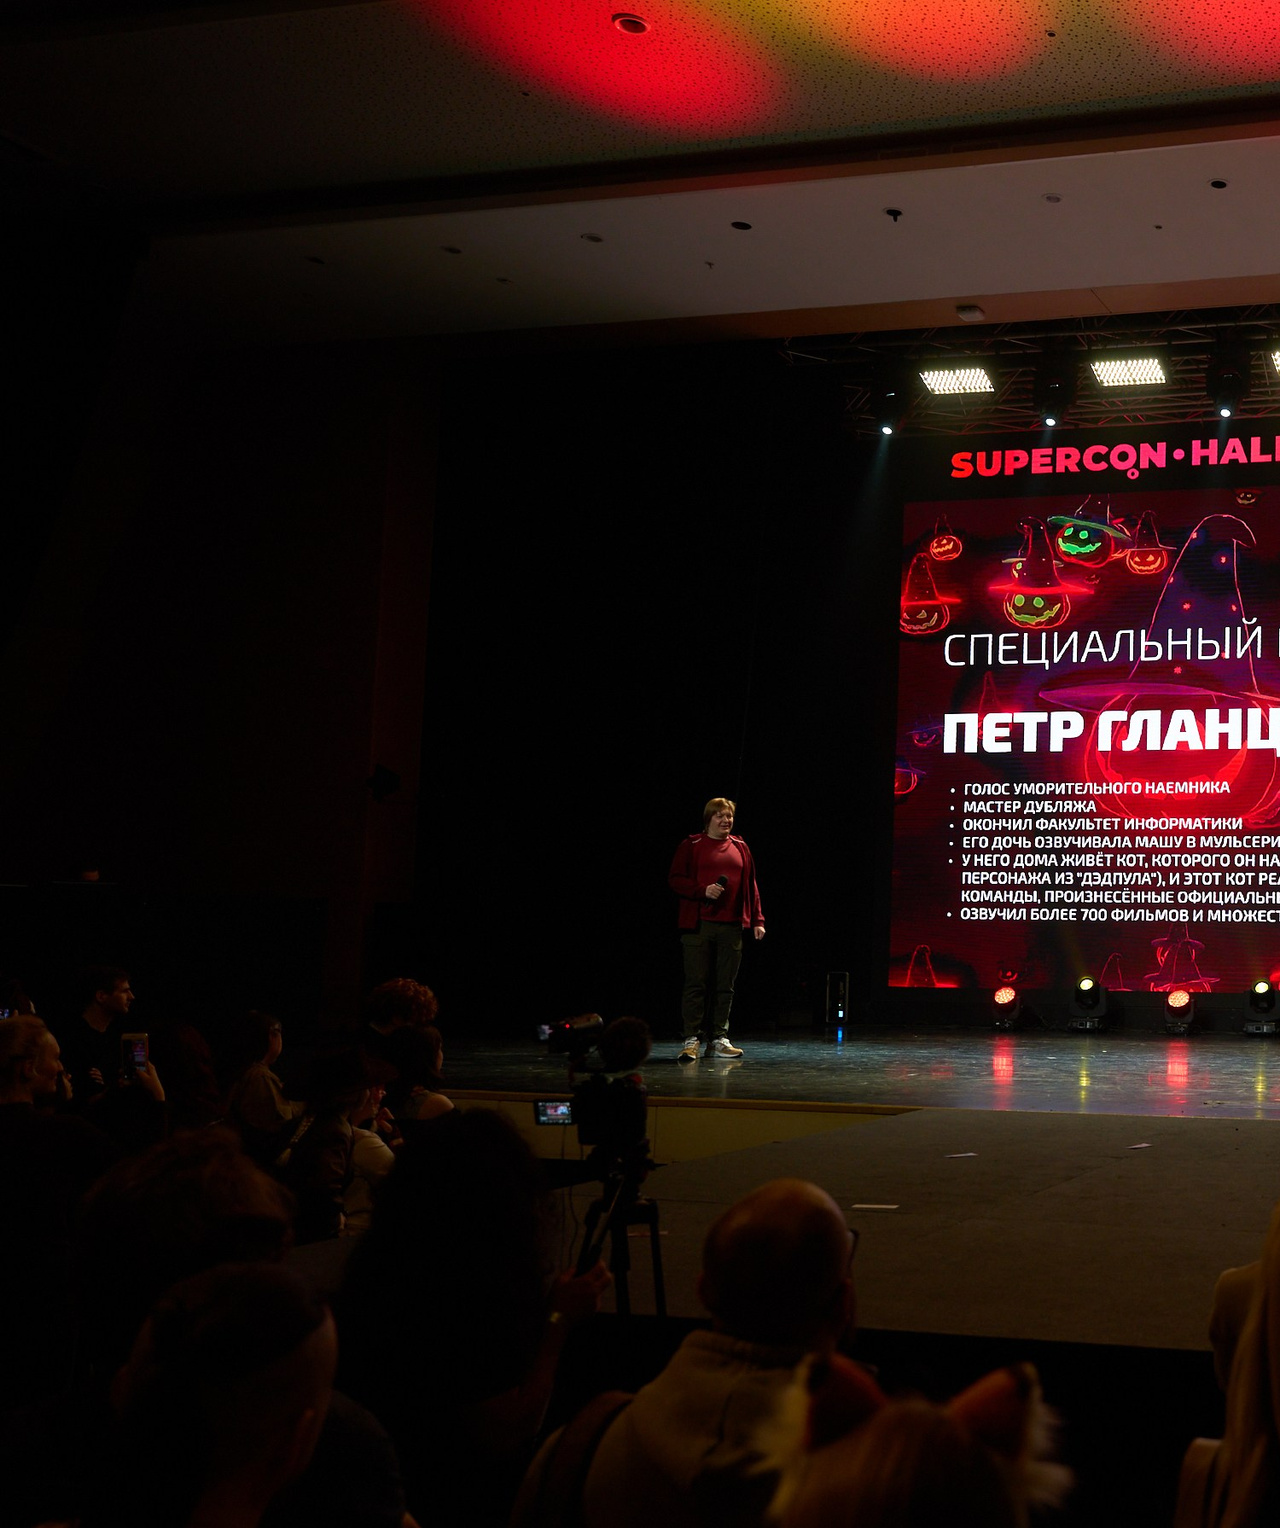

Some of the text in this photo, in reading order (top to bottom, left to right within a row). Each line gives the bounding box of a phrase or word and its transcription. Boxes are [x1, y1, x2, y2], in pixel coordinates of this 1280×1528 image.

[950, 440, 1166, 479] SUPERCON
[943, 617, 1263, 671] СПЕЦИАЛЬНЫЙ
[943, 711, 1084, 754] ПЕТР
[964, 781, 1231, 796] ГОЛОС УМОРИТЕЛЬНОГО НАЕМНИКА
[963, 800, 1097, 815] МАСТЕР ДУБЛЯЖА
[963, 817, 1243, 831] ОКОНЧИЛ ФАКУЛЬТЕТ ИНФОРМАТИКИ
[962, 836, 989, 849] ЕГО
[991, 836, 1032, 851] ДОЧЬ
[1034, 836, 1132, 849] ОЗВУЧИВАЛА
[1135, 836, 1183, 848] МАШУ
[1186, 836, 1196, 848] В
[961, 854, 971, 867] У
[974, 854, 1010, 867] НЕГО
[1013, 854, 1058, 869] ДОМА
[1060, 852, 1114, 867] ЖИВЁТ
[1116, 854, 1149, 869] КОТ,
[1151, 854, 1231, 867] КОТОРОГО
[1234, 854, 1256, 867] ОН
[961, 872, 1051, 885] ПЕРСОНАЖА
[1054, 872, 1074, 885] ИЗ
[1169, 873, 1180, 885] И
[1183, 873, 1222, 886] ЭТОТ
[1225, 873, 1255, 886] КОТ
[961, 890, 1041, 904] КОМАНДЫ,
[1044, 887, 1174, 904] ПРОИЗНЕСЁННЫЕ
[960, 908, 1027, 921] ОЗВУЧИЛ
[1030, 908, 1077, 921] БОЛЕЕ
[1080, 908, 1107, 921] 700
[1110, 909, 1189, 922] ФИЛЬМОВ
[1192, 909, 1203, 922] И
